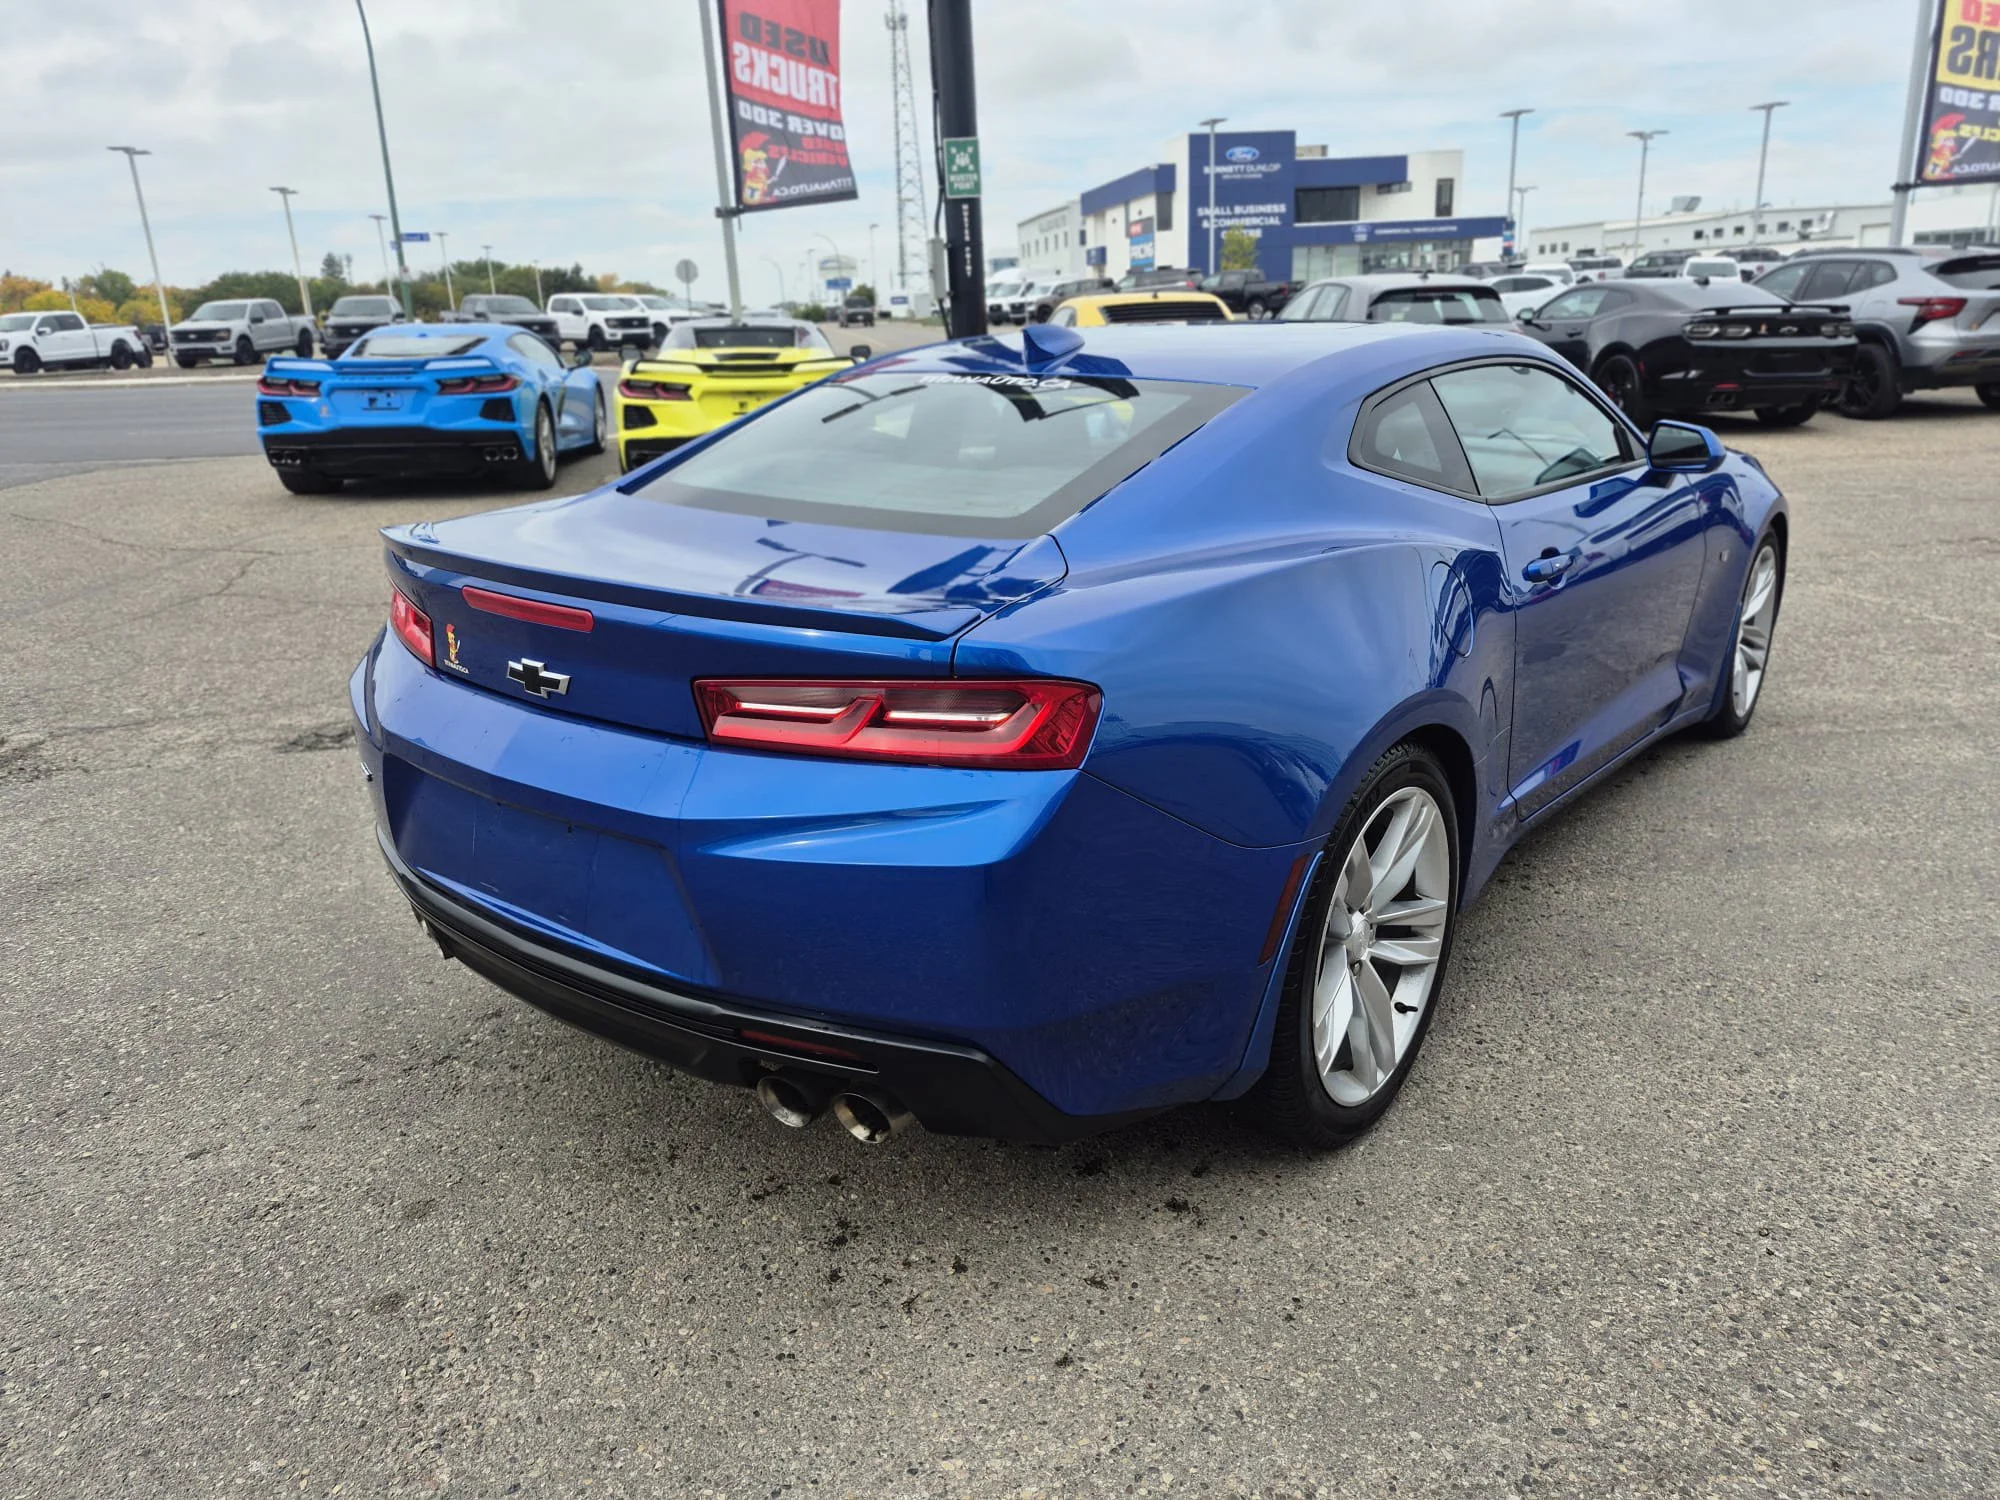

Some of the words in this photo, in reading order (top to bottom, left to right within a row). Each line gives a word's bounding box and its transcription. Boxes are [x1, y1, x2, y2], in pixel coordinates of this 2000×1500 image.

[1203, 164, 1245, 175] BNNETT
[1197, 206, 1232, 217] SMALL
[1233, 203, 1287, 215] BUSINESS
